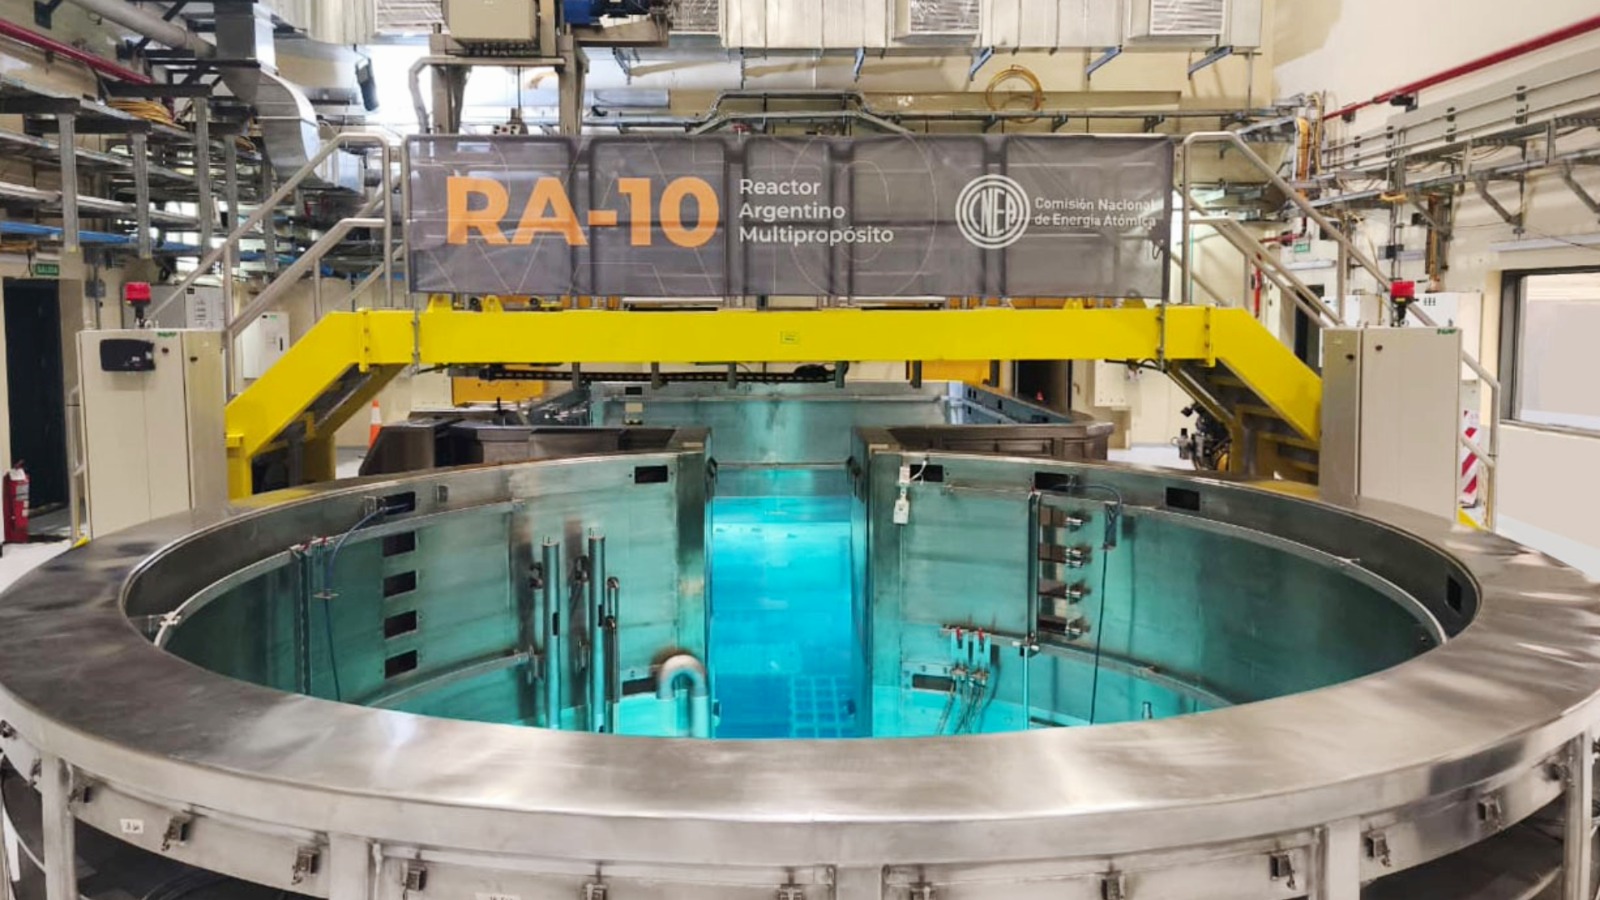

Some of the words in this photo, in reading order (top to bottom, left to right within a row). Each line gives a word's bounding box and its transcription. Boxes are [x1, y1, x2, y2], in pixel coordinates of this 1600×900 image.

[739, 179, 821, 195] Reactor
[446, 176, 719, 247] RA-10
[739, 202, 846, 222] Argentino
[969, 187, 1017, 236] CNEA
[1035, 197, 1094, 210] Comisión
[1098, 198, 1156, 211] Nacional
[1034, 213, 1050, 225] de
[1103, 214, 1156, 229] Atómica
[739, 225, 894, 247] Multipropósito
